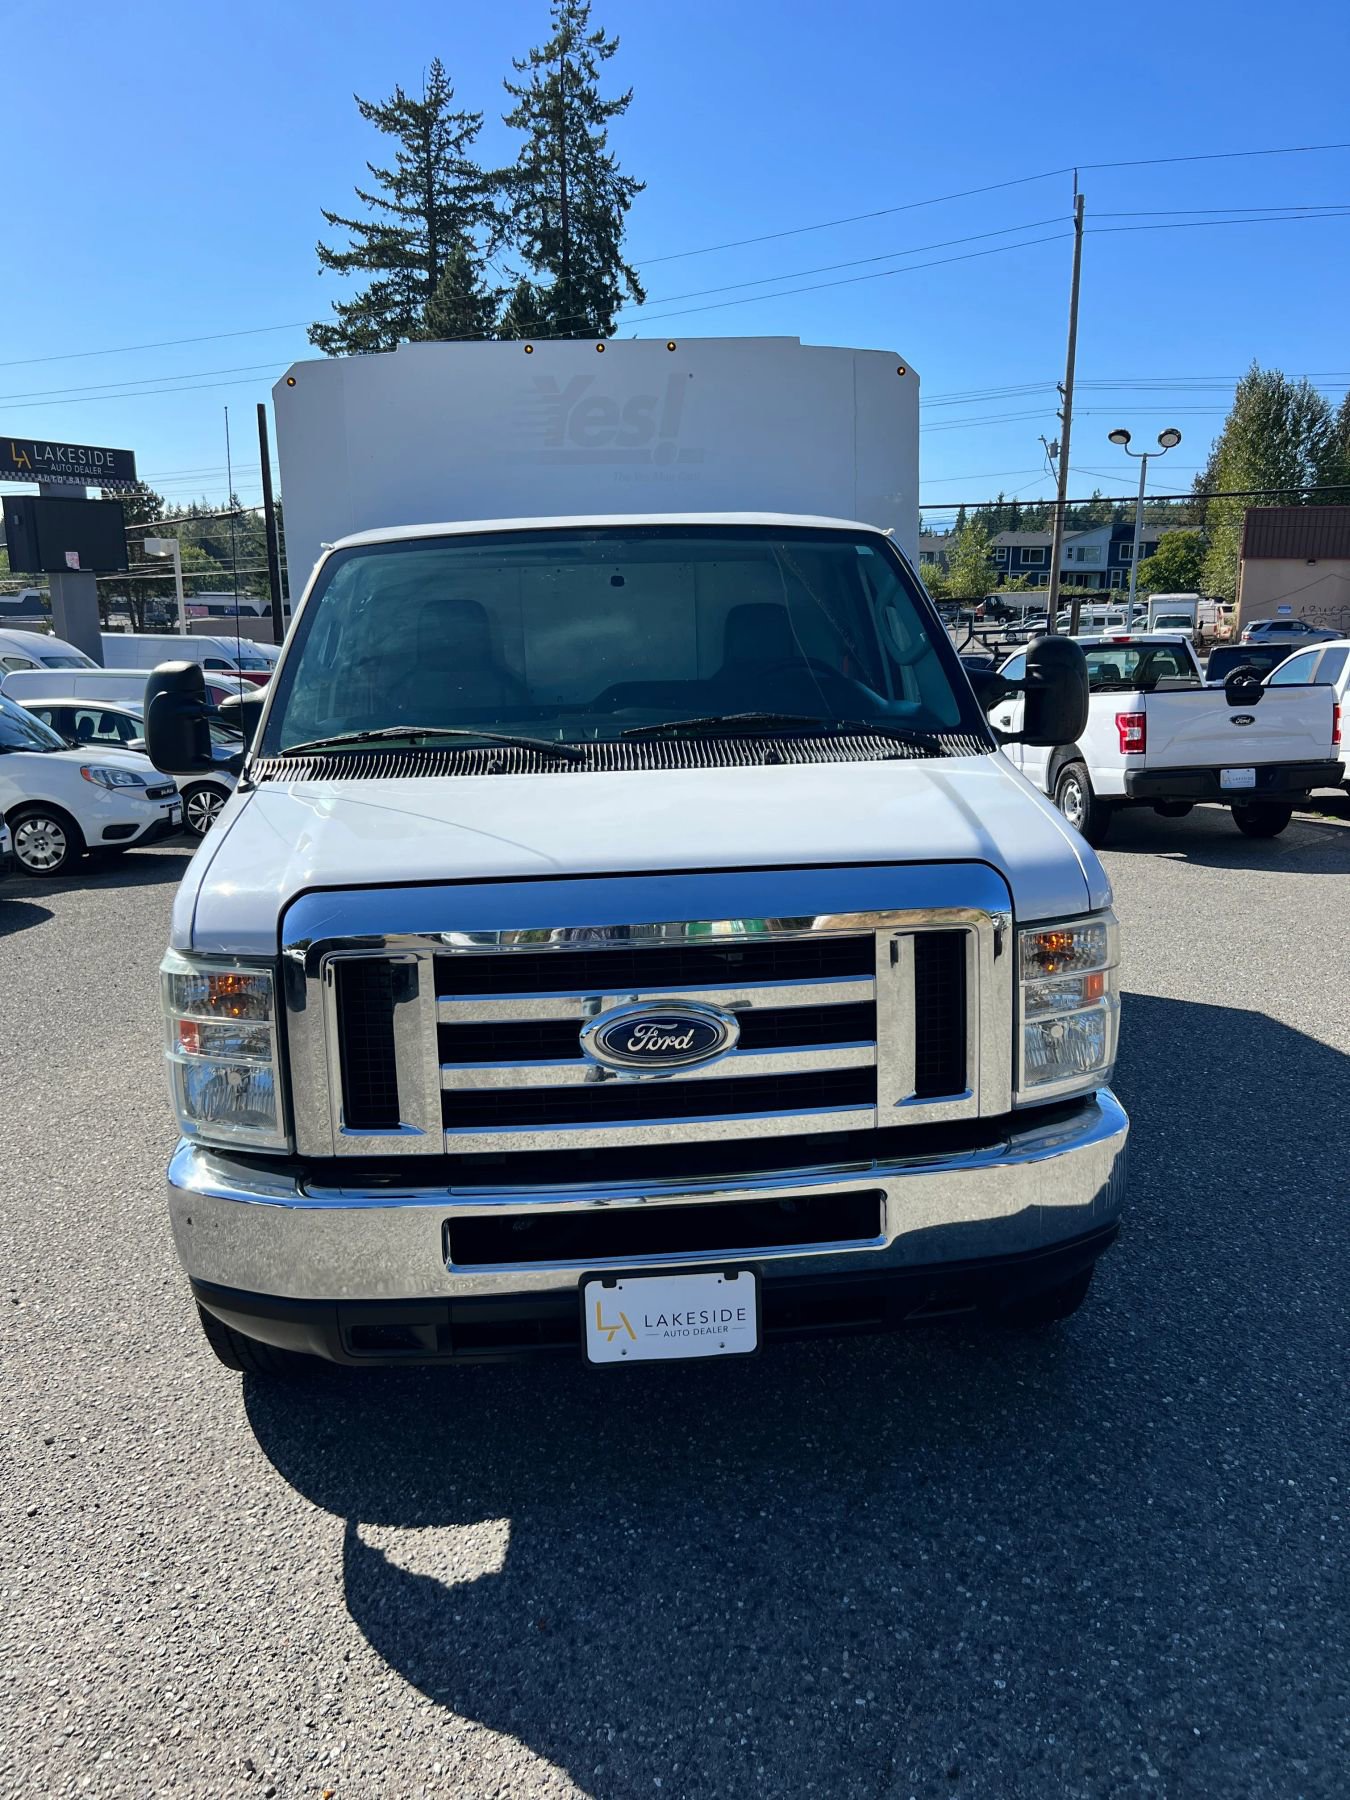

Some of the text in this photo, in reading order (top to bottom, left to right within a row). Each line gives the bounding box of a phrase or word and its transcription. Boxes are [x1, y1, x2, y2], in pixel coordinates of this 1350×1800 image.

[531, 372, 688, 466] Yes!
[33, 444, 115, 467] LAKESIDE
[50, 463, 102, 475] AUTO DEALER
[37, 475, 99, 486] AUTO SALES
[627, 1023, 695, 1052] Ford
[595, 1300, 638, 1343] LA
[644, 1307, 747, 1328] LAKESIDE
[663, 1325, 729, 1338] AUTO DEALER
